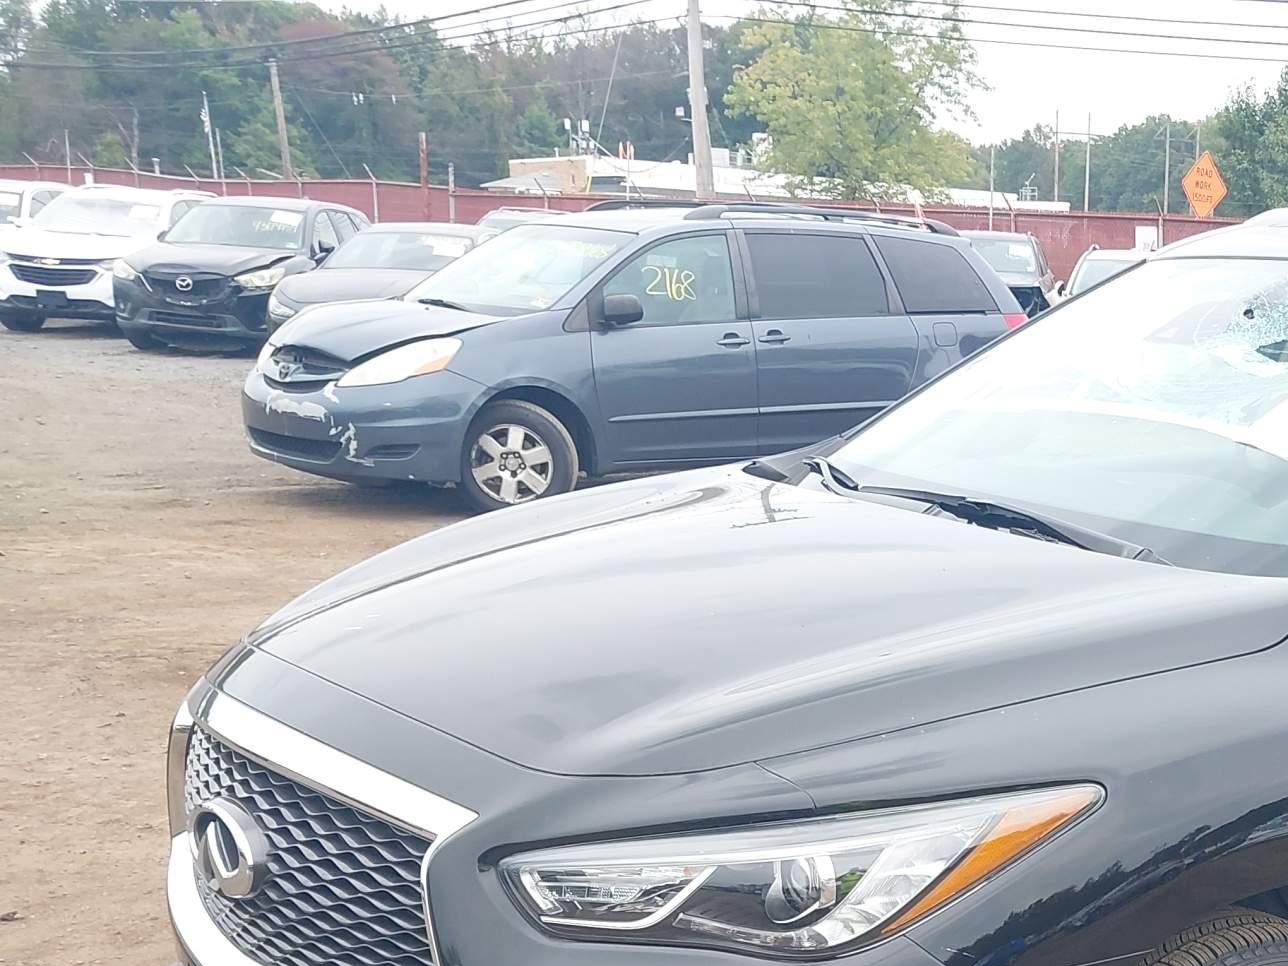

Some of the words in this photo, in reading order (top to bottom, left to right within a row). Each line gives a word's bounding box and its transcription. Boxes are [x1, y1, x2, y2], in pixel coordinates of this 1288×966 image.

[1196, 166, 1213, 178] ROAD
[1195, 180, 1212, 191] WORK
[640, 265, 697, 301] 2168
